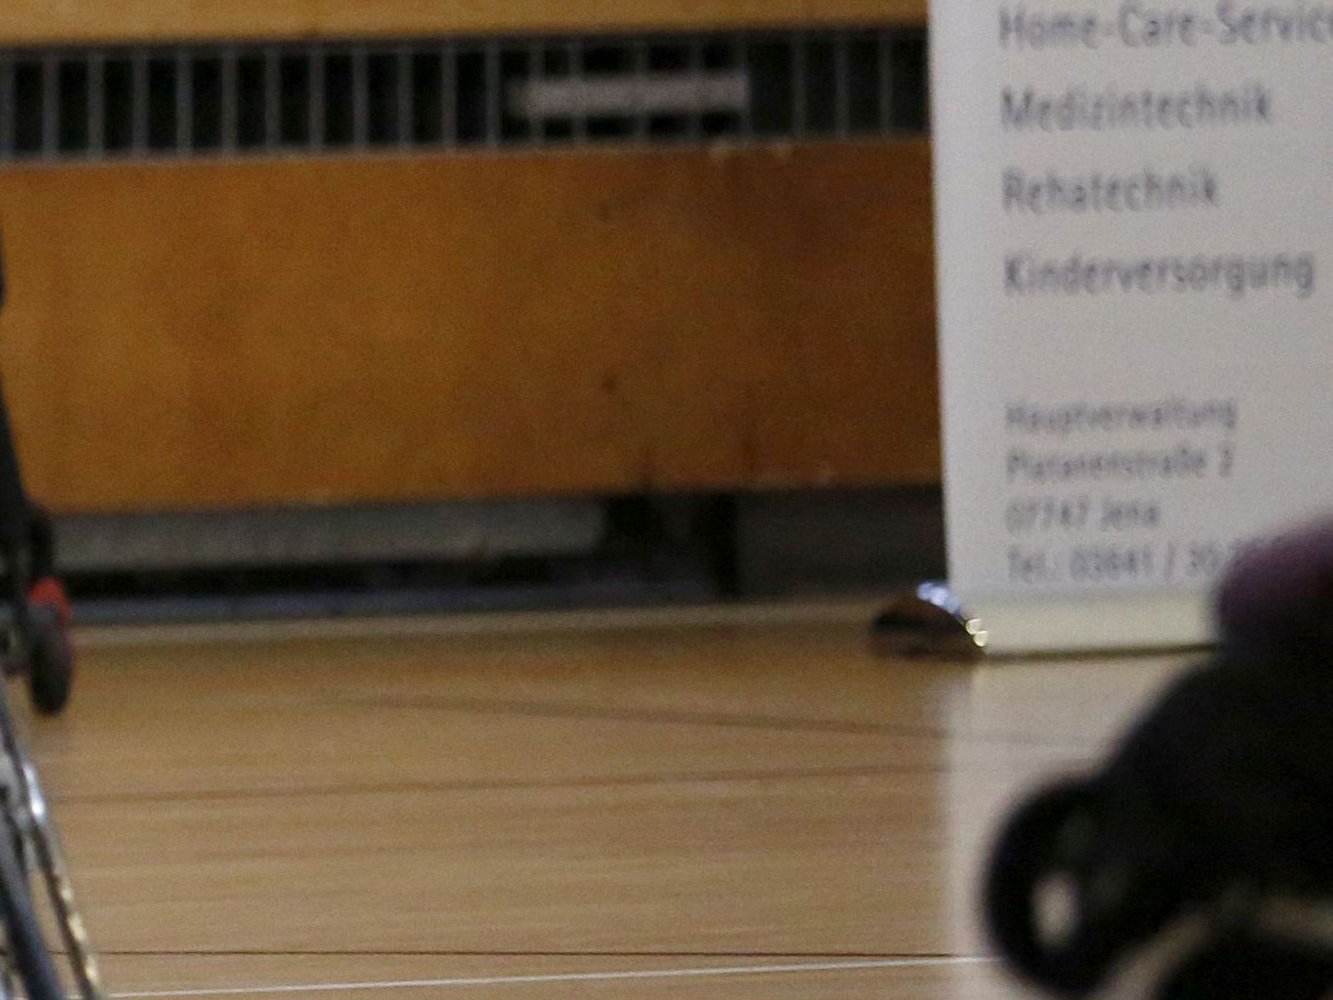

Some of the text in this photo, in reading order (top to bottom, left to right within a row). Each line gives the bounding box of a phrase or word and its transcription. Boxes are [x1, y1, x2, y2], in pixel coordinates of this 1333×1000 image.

[1001, 80, 1271, 132] Medizintechnik
[1002, 165, 1219, 214] Rehatechnik
[1004, 250, 1317, 299] Kinderversorgung
